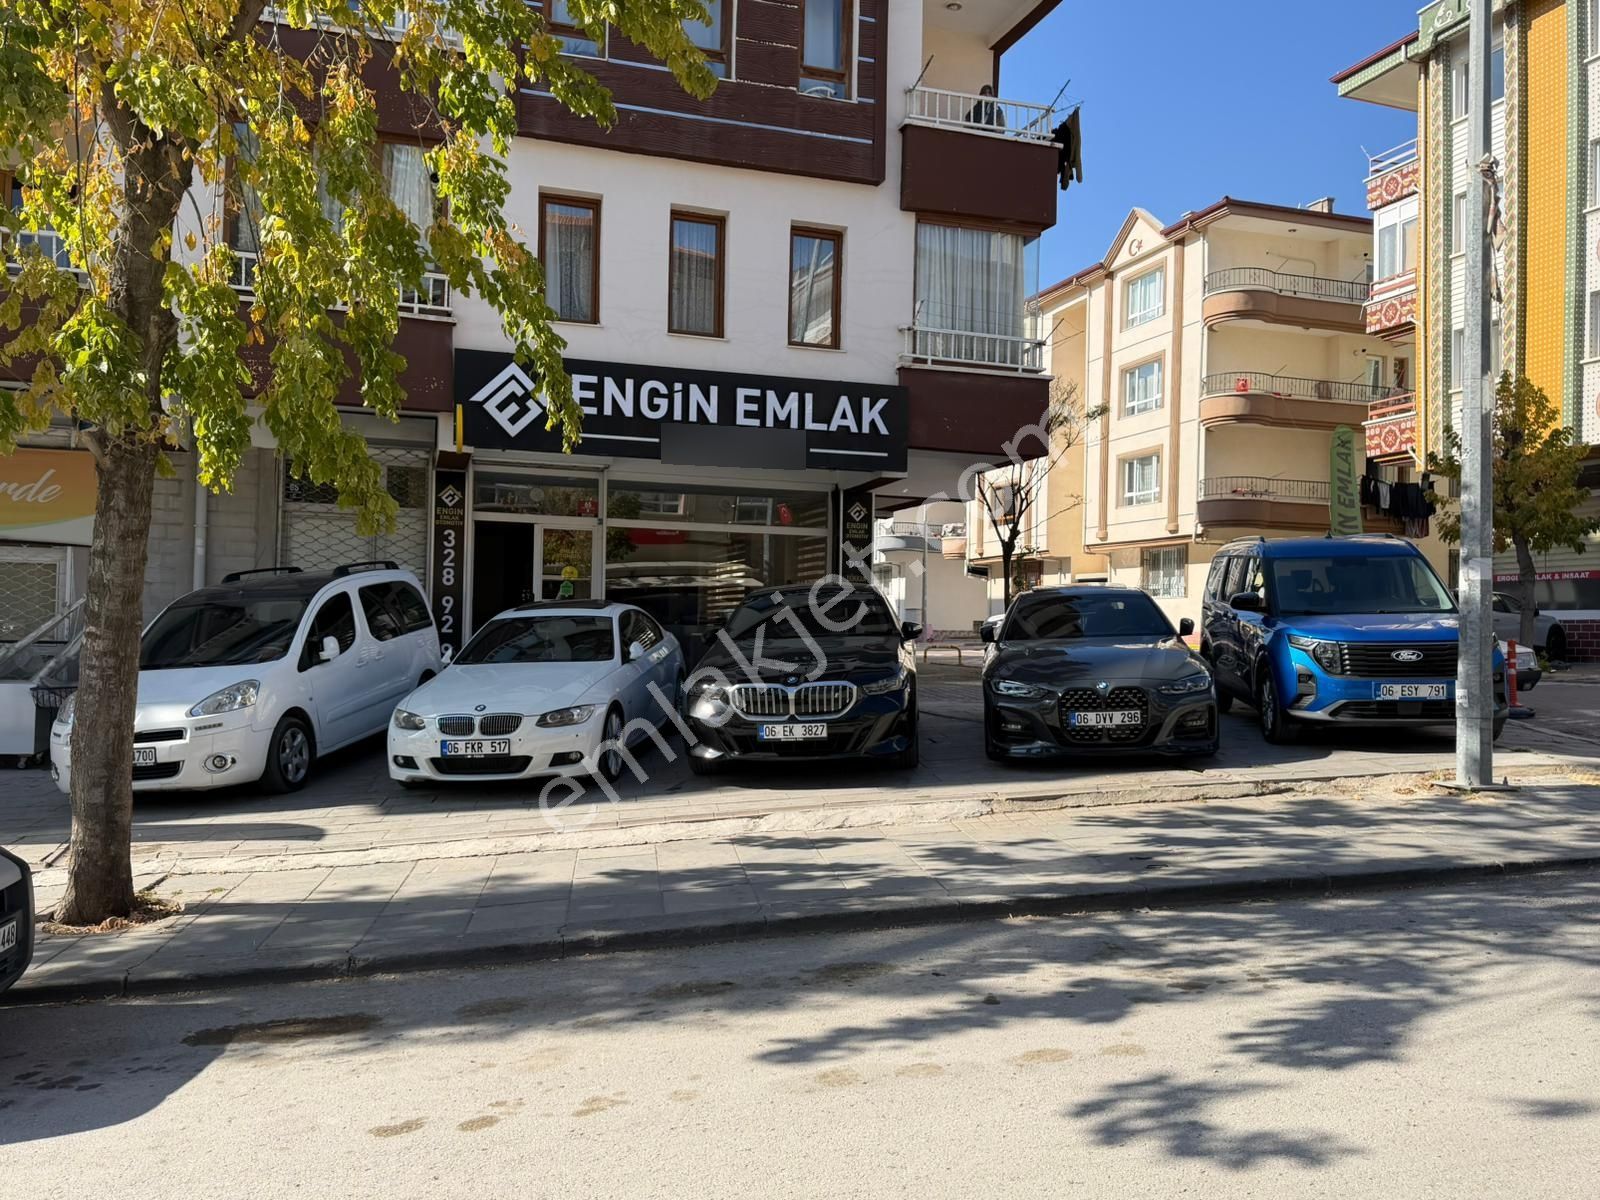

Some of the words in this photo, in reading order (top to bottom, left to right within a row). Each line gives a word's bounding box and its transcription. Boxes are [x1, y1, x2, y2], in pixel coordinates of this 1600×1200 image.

[735, 387, 890, 436] EMLAK
[1336, 435, 1356, 508] EMLAK
[1381, 686, 1394, 696] 06
[1400, 685, 1420, 696] ESY
[1427, 685, 1445, 696] 791
[1076, 713, 1089, 724] 06
[1120, 711, 1140, 723] 296
[764, 726, 777, 737] 06
[782, 725, 795, 737] EK
[801, 724, 825, 736] 3827
[447, 742, 459, 753] 06
[464, 742, 483, 753] FKR
[490, 741, 508, 753] 517
[133, 750, 154, 762] 700
